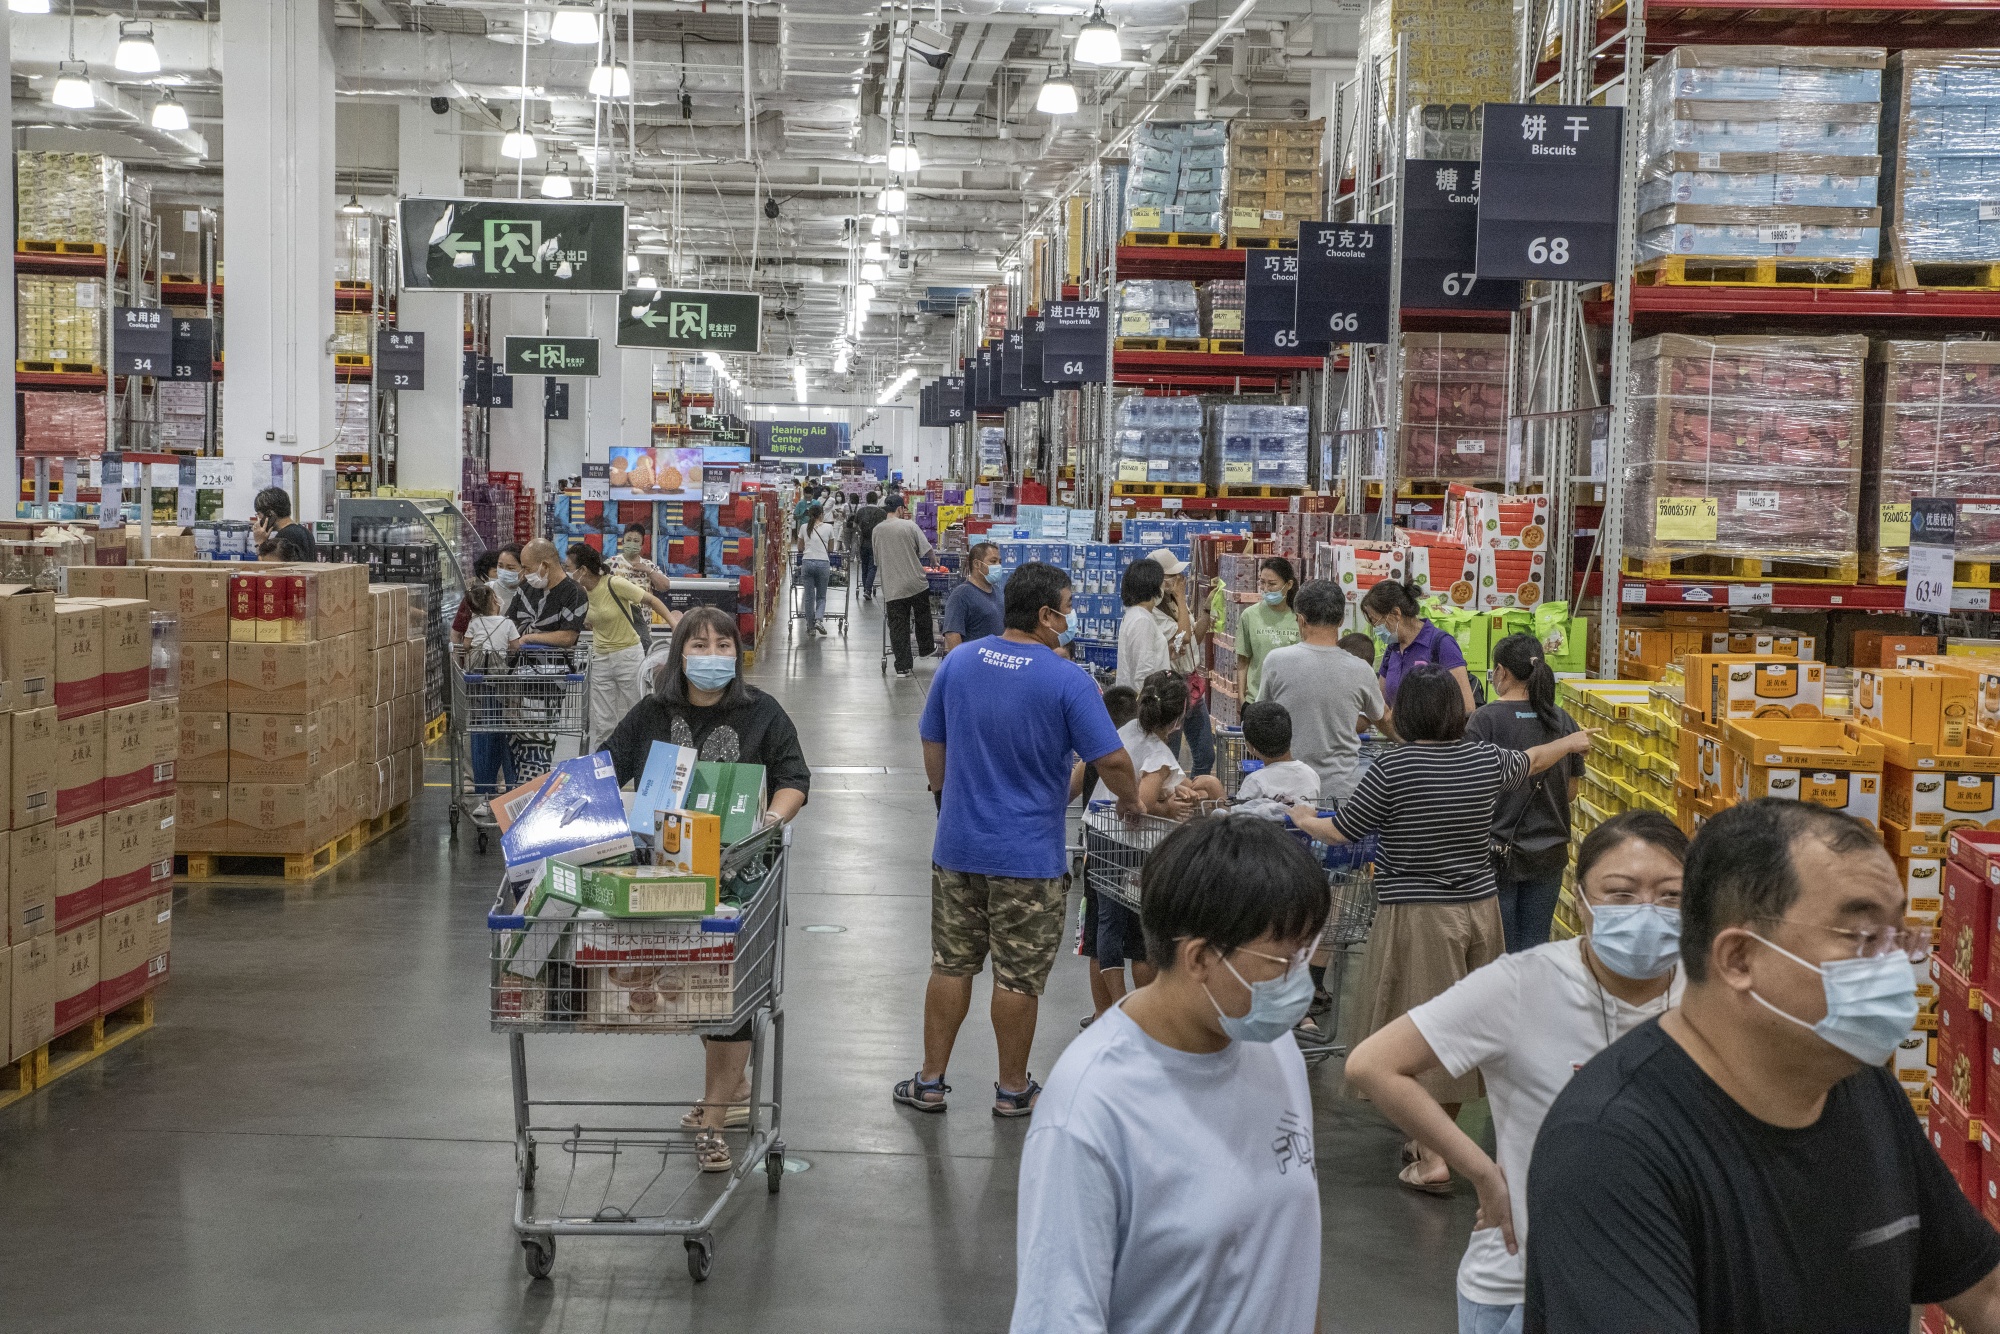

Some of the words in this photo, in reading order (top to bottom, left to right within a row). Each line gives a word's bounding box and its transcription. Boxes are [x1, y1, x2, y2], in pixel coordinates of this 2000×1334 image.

[1521, 114, 1590, 142] 饼干
[1531, 143, 1577, 157] Biscuits
[1448, 192, 1479, 205] Candy
[1317, 230, 1375, 249] 巧克力
[1326, 249, 1366, 259] Chocolate
[1527, 236, 1570, 265] 68
[1442, 272, 1478, 296] 67
[126, 311, 160, 323] 食用油
[1050, 305, 1100, 319] 进口牛奶
[180, 321, 191, 332] 米
[708, 323, 737, 332] 安全出口
[1059, 318, 1077, 326] Import
[1329, 311, 1359, 332] 66
[390, 334, 414, 345] 杂粮
[1273, 329, 1300, 348] 65
[134, 358, 152, 371] 34
[1063, 361, 1084, 375] 64
[175, 365, 192, 377] 33
[394, 375, 409, 386] 32
[949, 409, 961, 418] 56
[771, 425, 809, 437] Hearing
[810, 426, 827, 435] Aid
[771, 434, 802, 444] Center
[770, 444, 805, 454] 助听中心
[202, 474, 233, 487] 224.90
[1926, 512, 1955, 527] 优质优价
[1751, 592, 1770, 601] 46.80
[1915, 580, 1943, 603] 63.40
[977, 647, 1033, 666] PERFECT
[982, 657, 1021, 671] CENTURY
[1809, 669, 1820, 678] 12
[1765, 679, 1788, 687] 蛋黄酥
[1786, 756, 1808, 764] 蛋黄酥
[1862, 779, 1874, 789] 12
[1811, 788, 1837, 797] 蛋黄酥
[1956, 791, 1982, 800] 蛋黄酥
